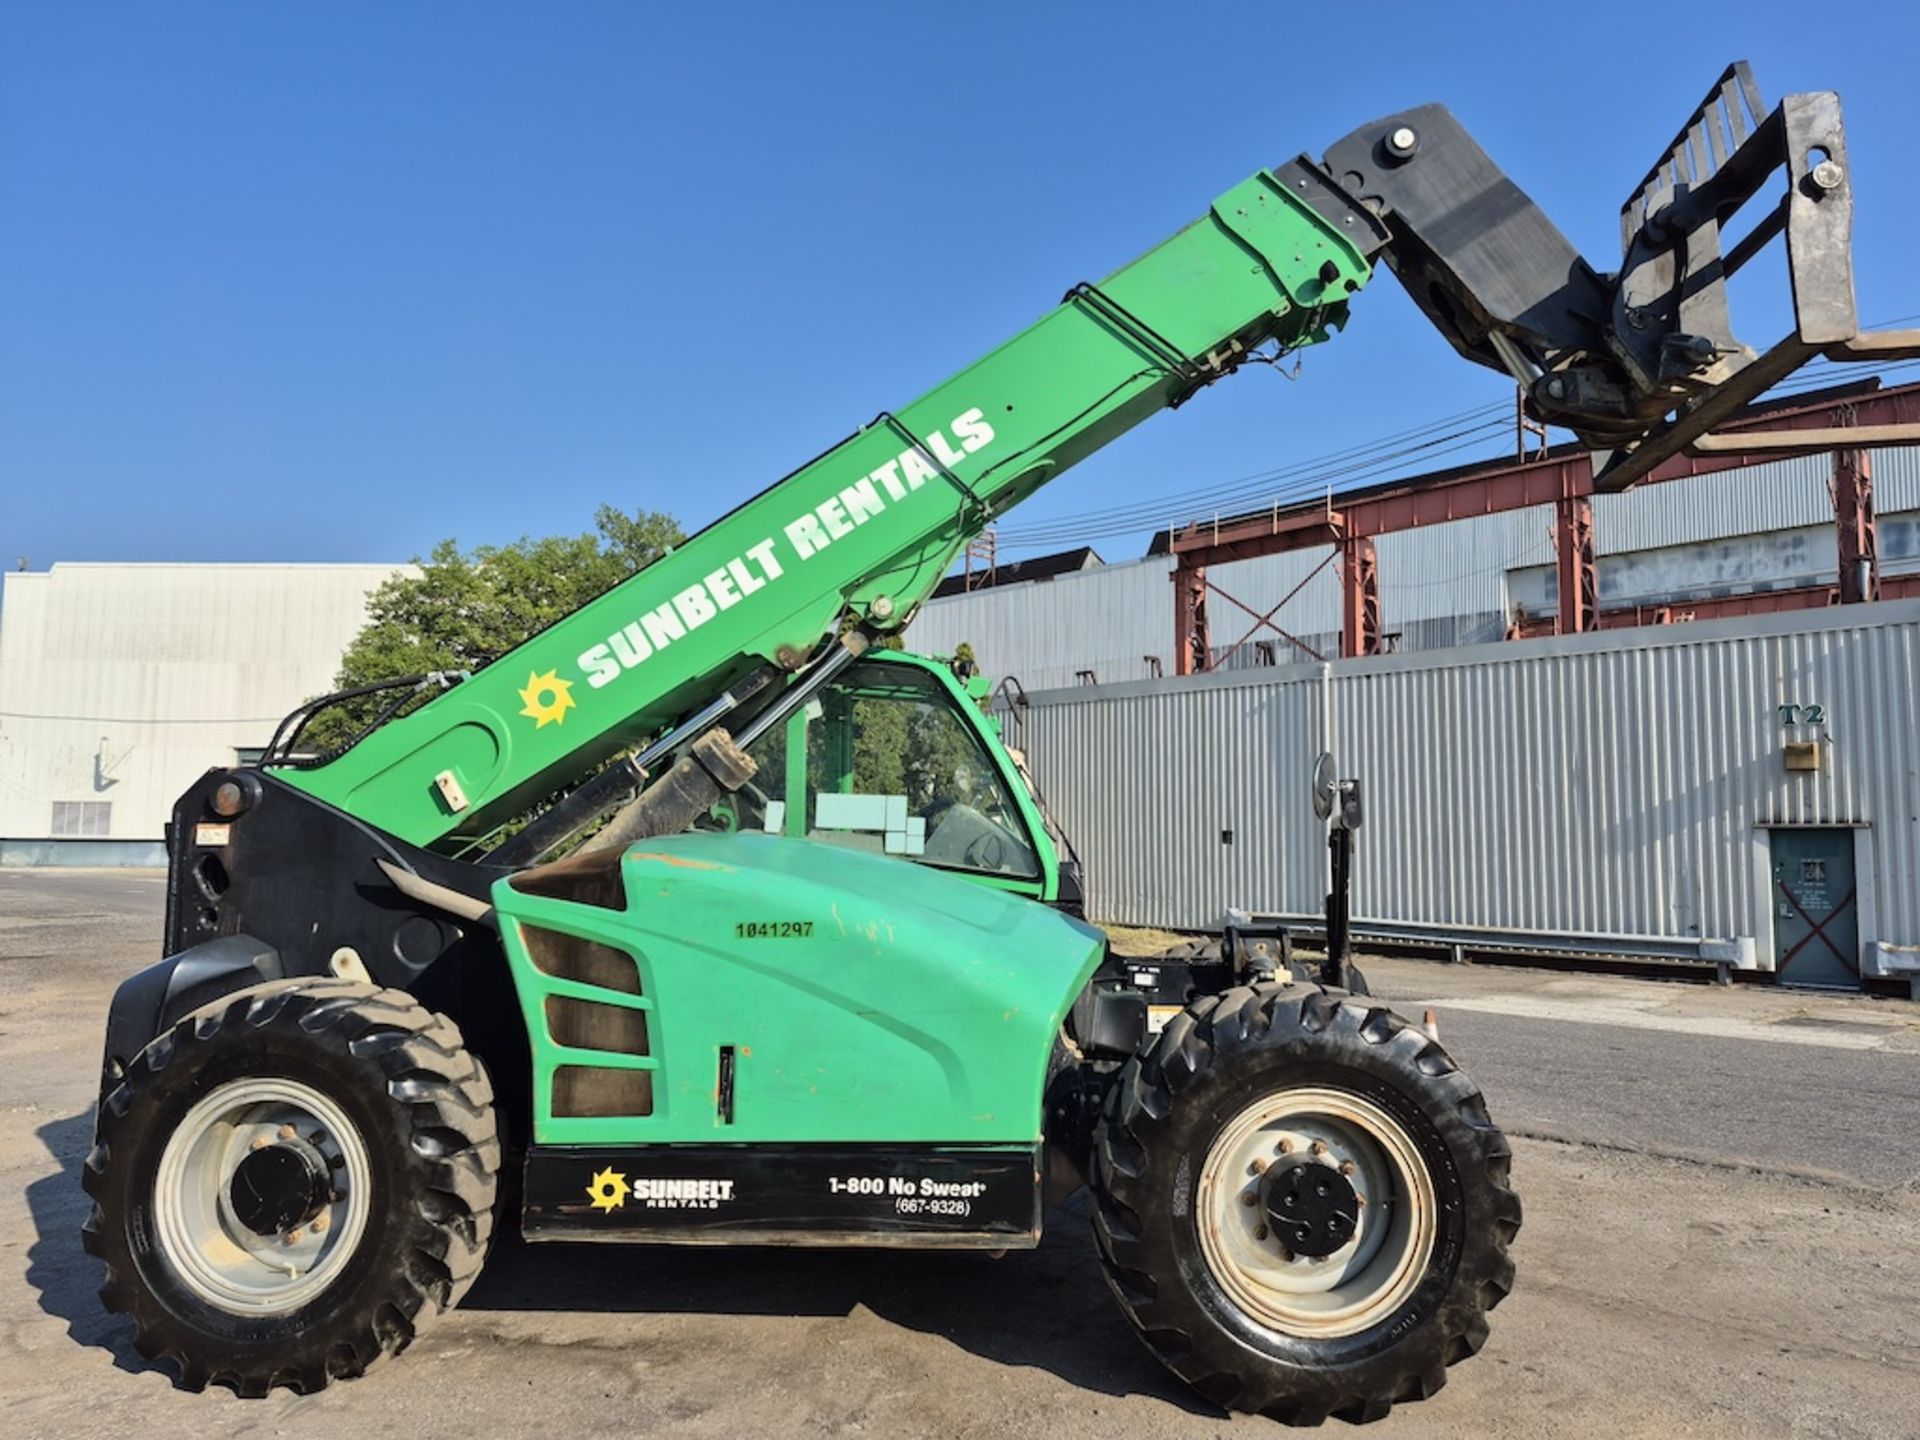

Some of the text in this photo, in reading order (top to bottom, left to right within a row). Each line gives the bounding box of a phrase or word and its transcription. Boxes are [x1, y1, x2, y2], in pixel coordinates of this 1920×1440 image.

[577, 407, 995, 689] SUNBELT RENTALS
[1778, 704, 1823, 724] T2
[736, 922, 813, 938] 1041297
[633, 1179, 734, 1200] SUNBELT
[828, 1177, 885, 1194] 1-800
[888, 1177, 917, 1195] No
[646, 1200, 719, 1209] RENTALS
[895, 1197, 970, 1217] (667-9328)
